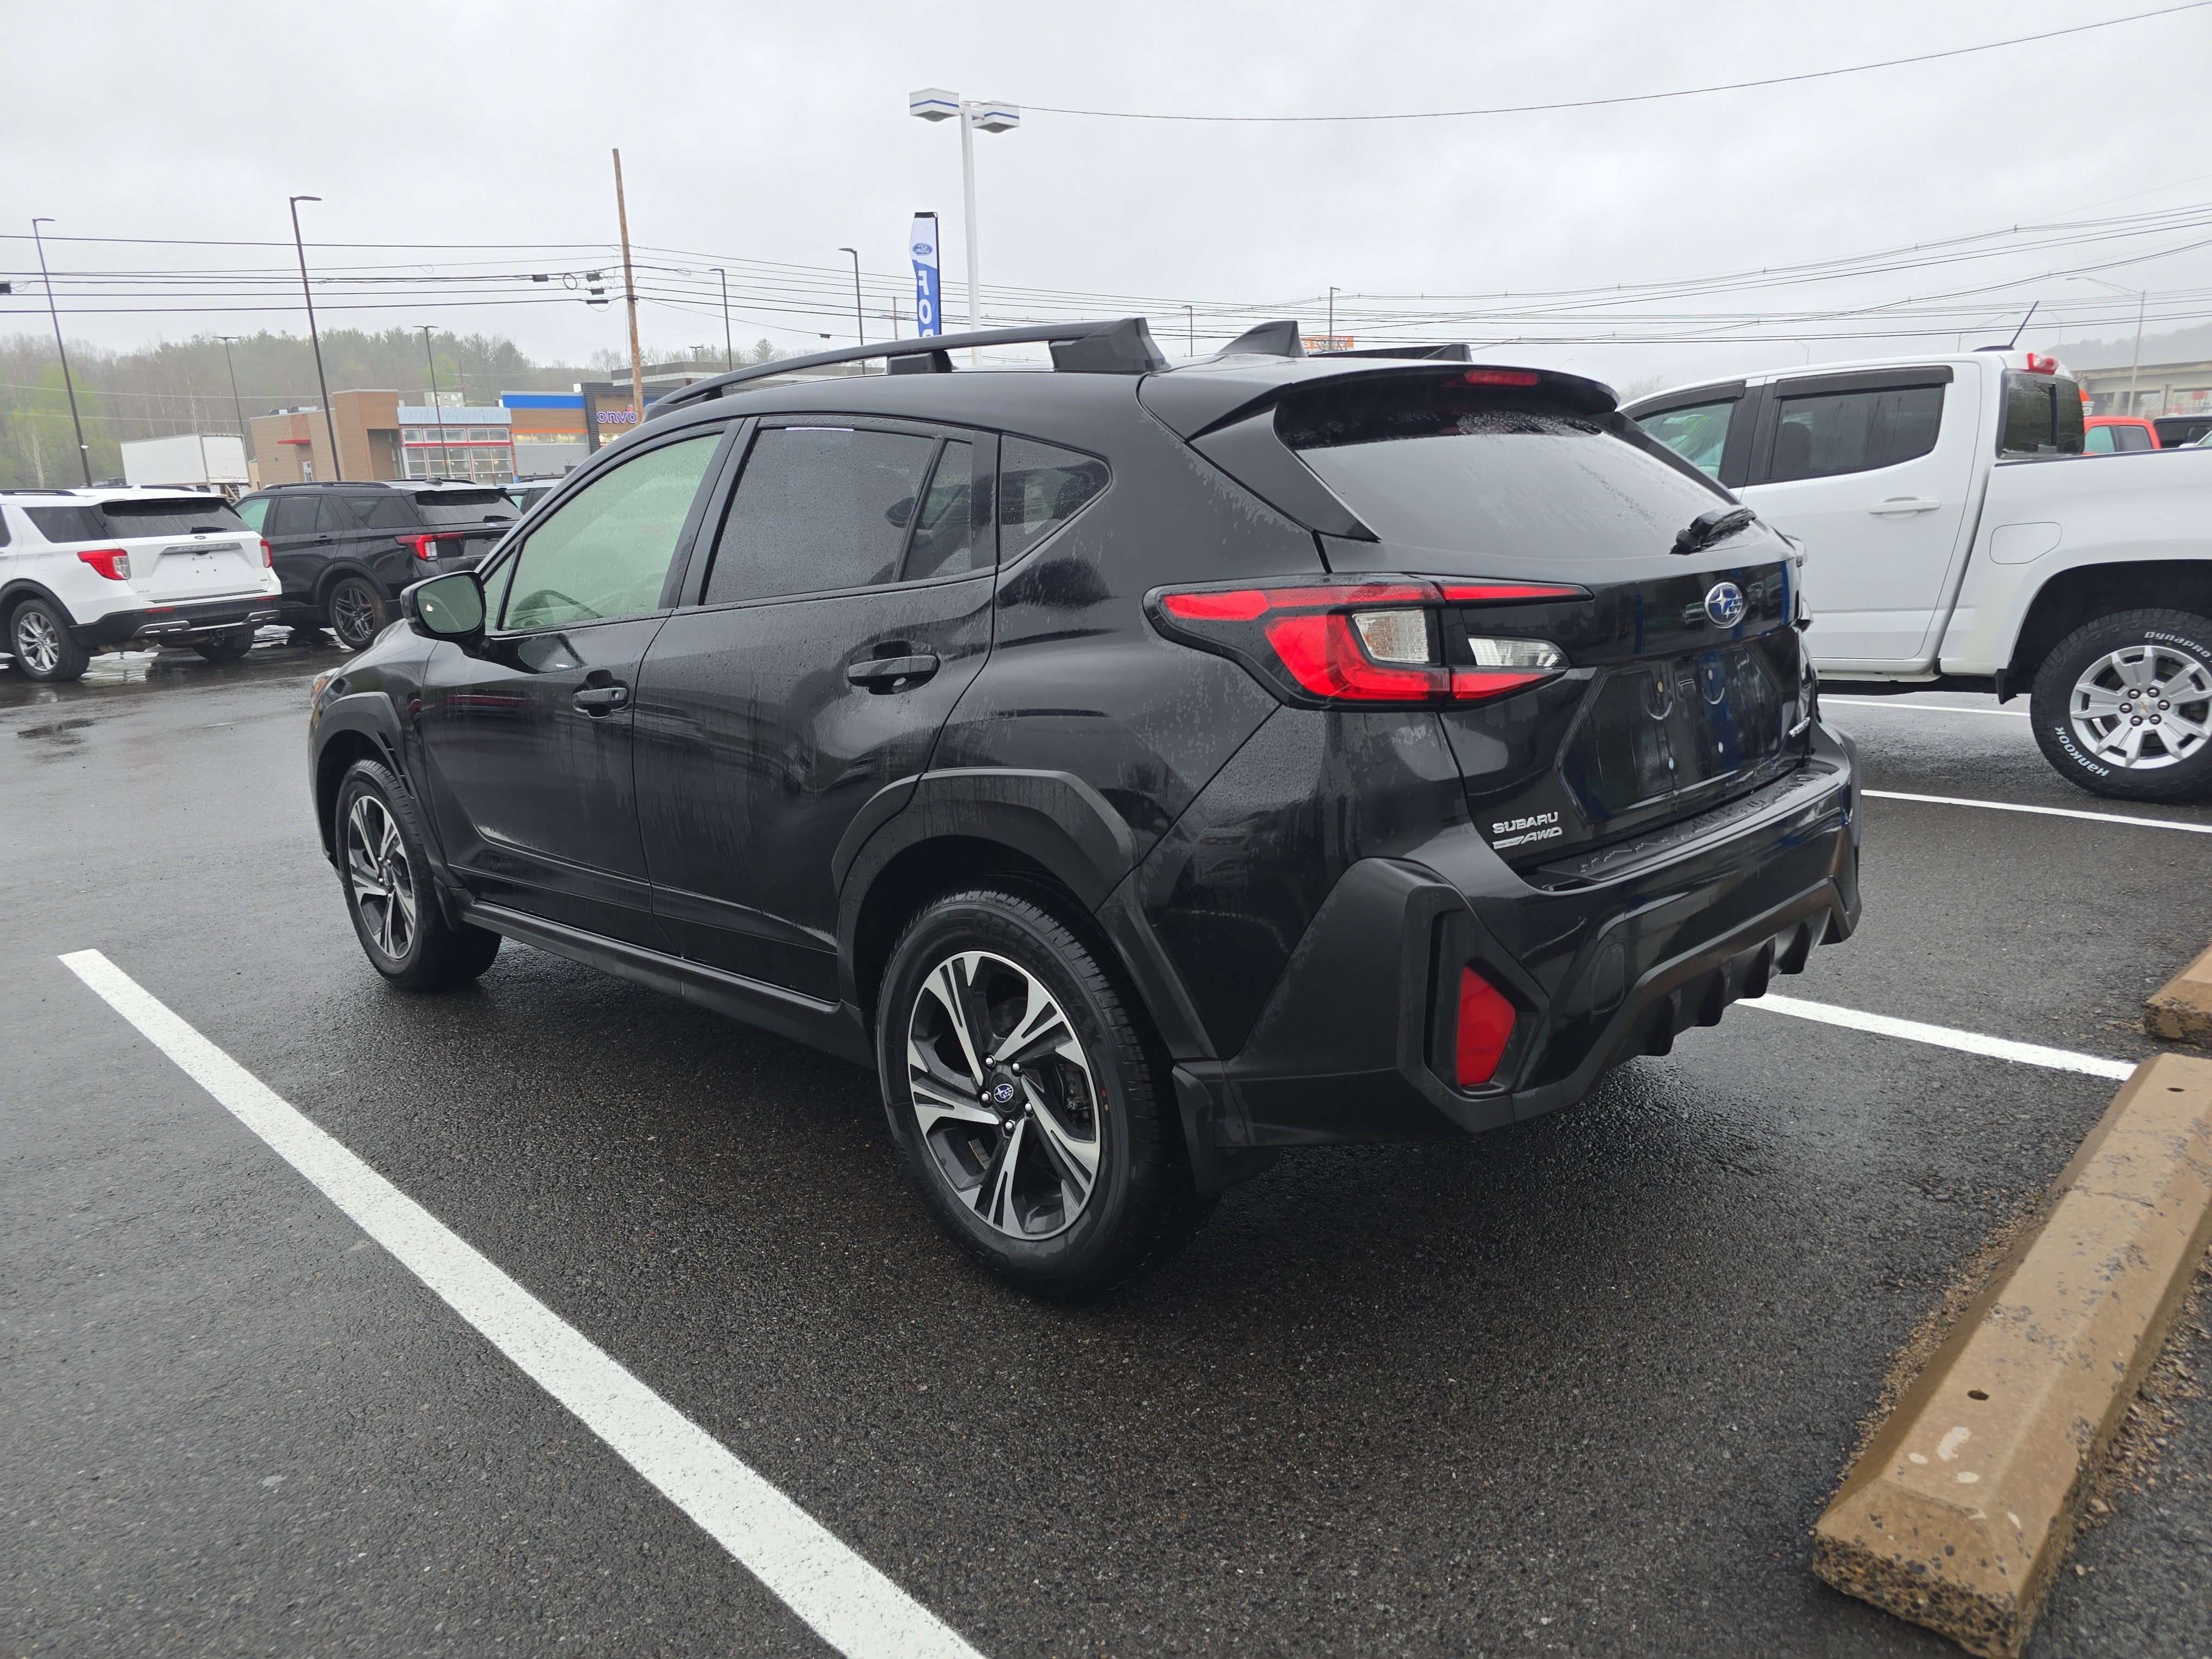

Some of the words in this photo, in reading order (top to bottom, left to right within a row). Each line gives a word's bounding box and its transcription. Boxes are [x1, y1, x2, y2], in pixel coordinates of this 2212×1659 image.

[597, 411, 637, 423] onvo
[1492, 811, 1558, 834] SUBARU
[1520, 826, 1562, 844] AWD
